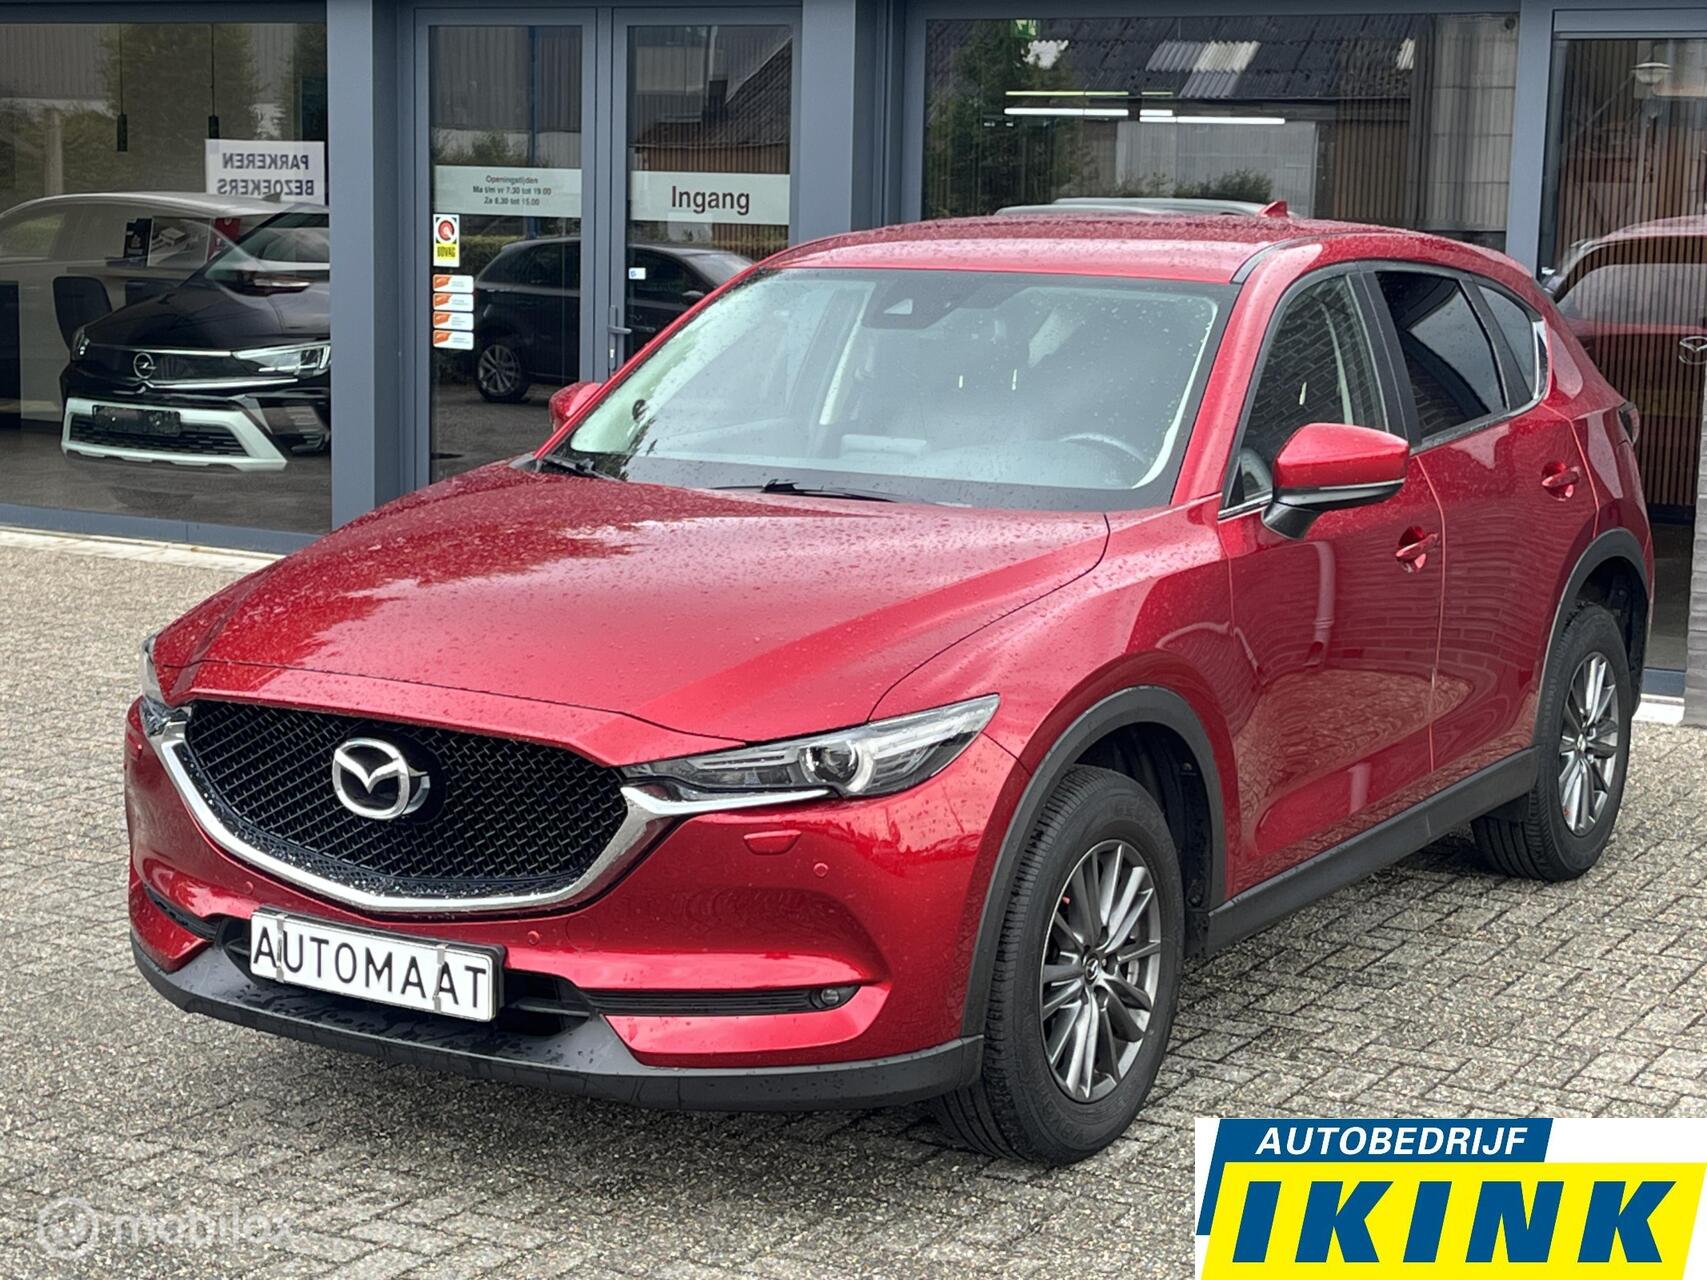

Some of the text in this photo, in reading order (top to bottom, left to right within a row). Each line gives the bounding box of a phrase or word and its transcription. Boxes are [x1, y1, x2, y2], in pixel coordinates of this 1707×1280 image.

[485, 175, 539, 185] Openingstijden
[473, 185, 483, 193] Ma
[521, 187, 532, 195] tot
[484, 196, 493, 204] Za
[671, 185, 750, 216] Ingang
[252, 926, 487, 1008] AUTOMAAT
